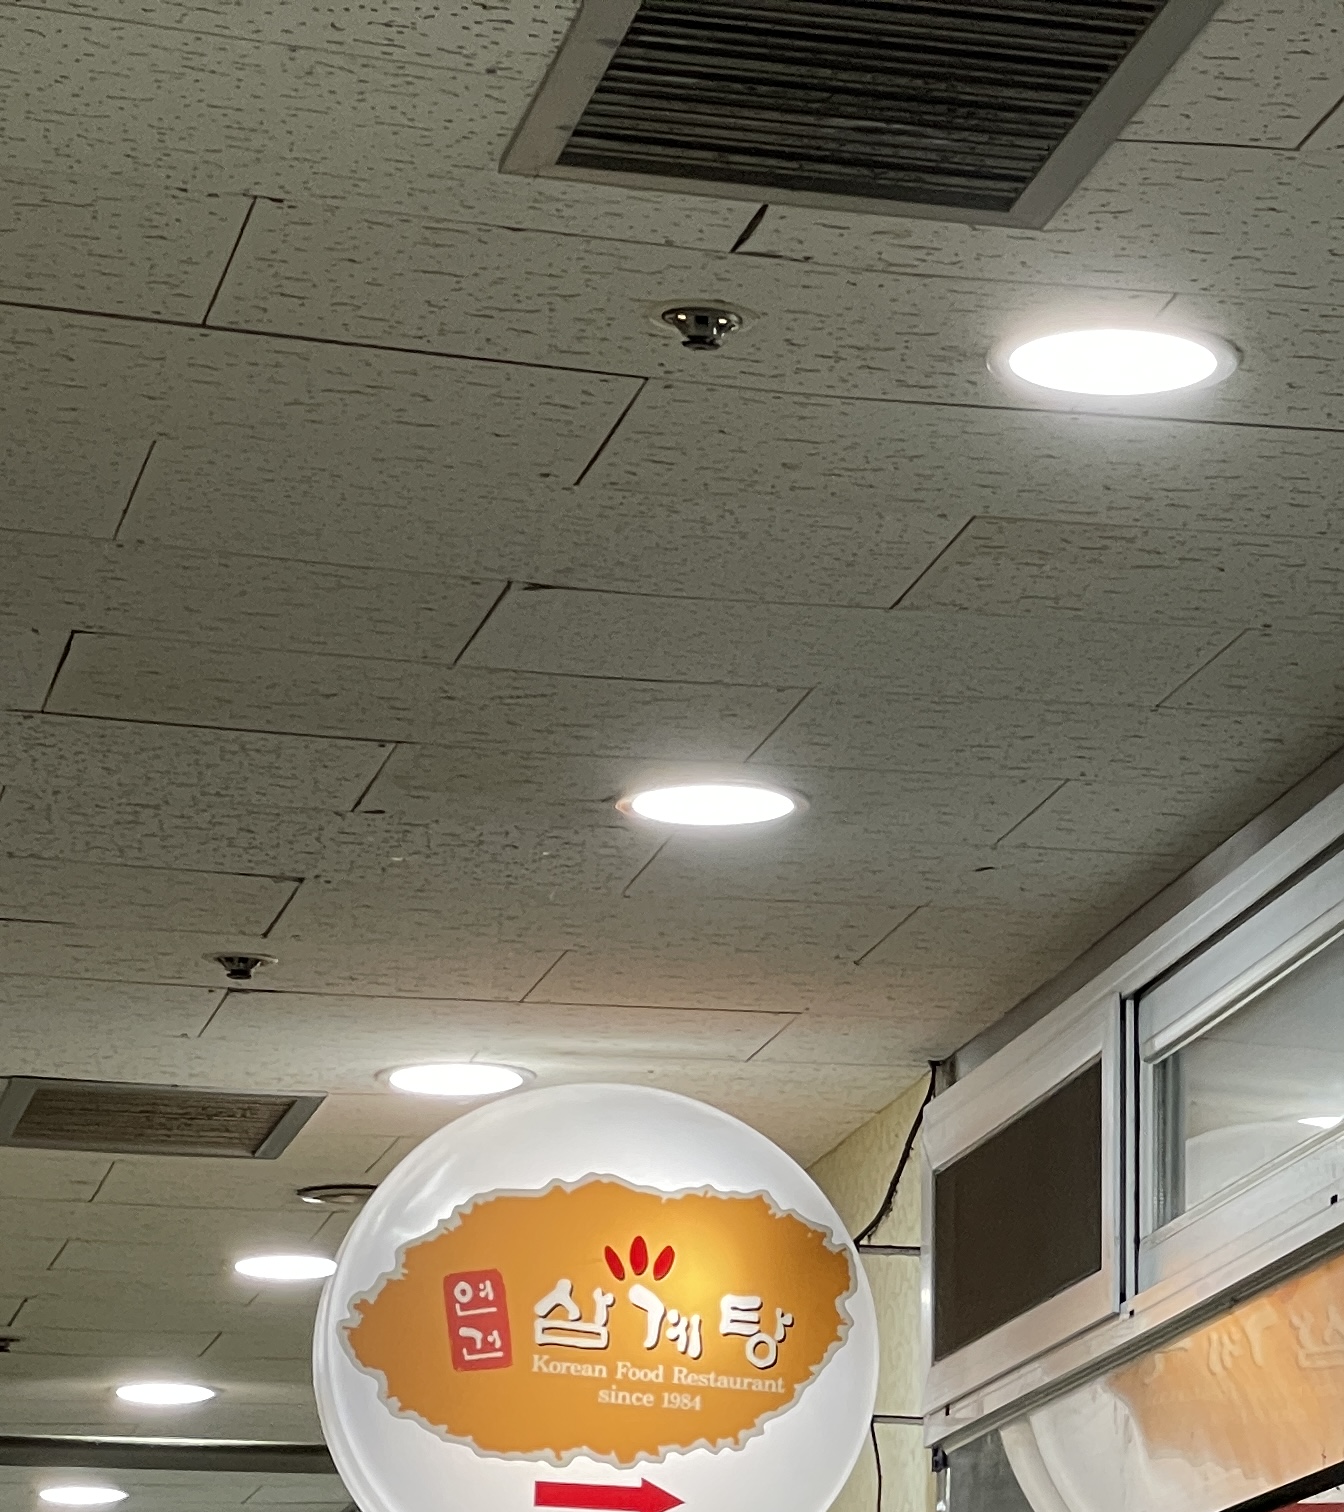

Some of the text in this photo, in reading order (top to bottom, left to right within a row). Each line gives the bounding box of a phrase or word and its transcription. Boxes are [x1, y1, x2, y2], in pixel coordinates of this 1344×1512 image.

[533, 1278, 794, 1370] 삼계탕
[531, 1353, 786, 1394] Korean Food Restaurant
[598, 1386, 702, 1412] since 1984
